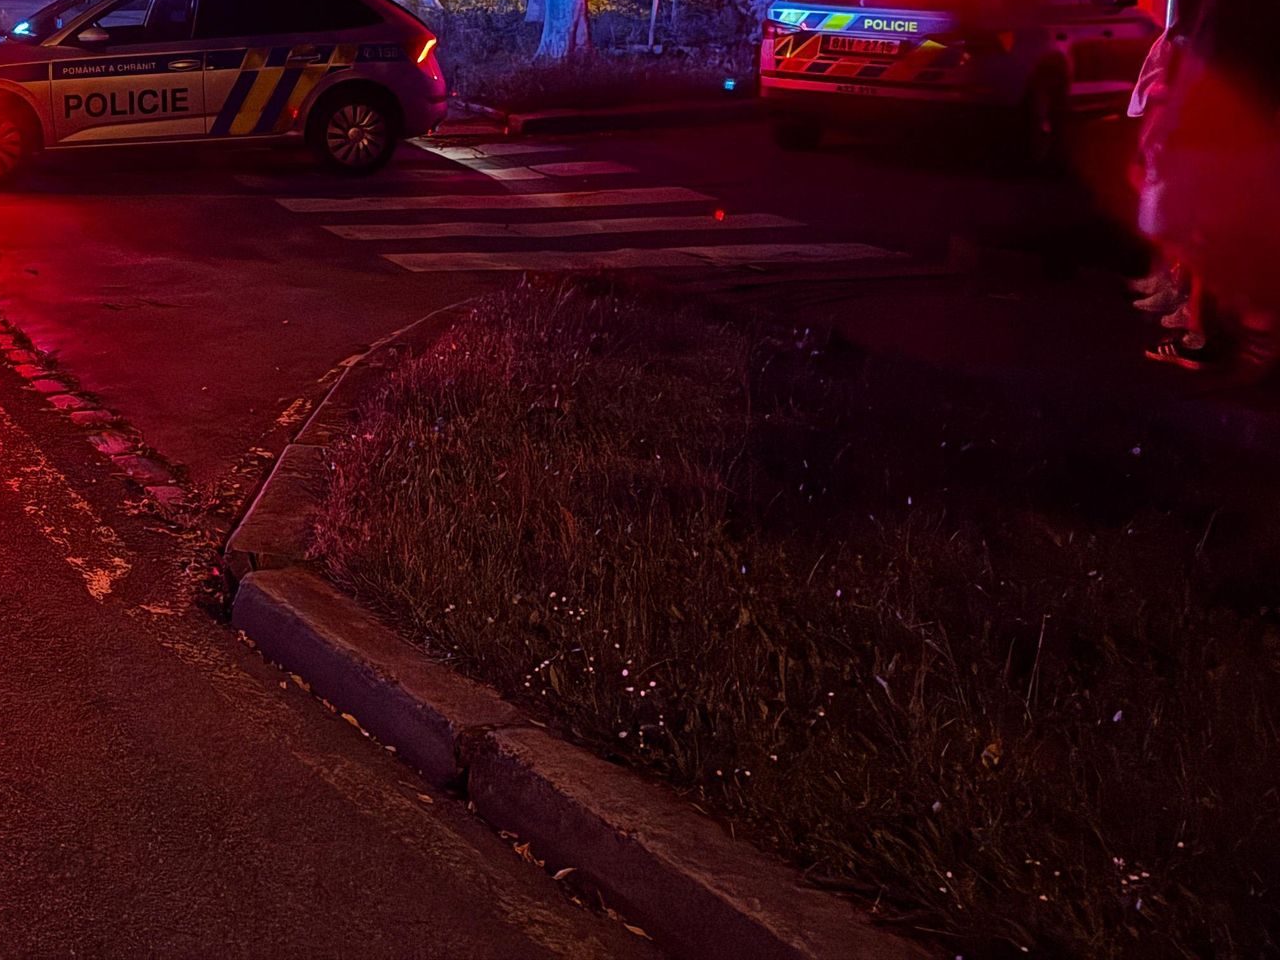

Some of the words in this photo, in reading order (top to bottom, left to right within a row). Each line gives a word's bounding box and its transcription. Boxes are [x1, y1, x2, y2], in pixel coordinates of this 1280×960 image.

[864, 18, 918, 32] POLICIE
[108, 64, 115, 72] A
[64, 88, 189, 119] POLICIE
